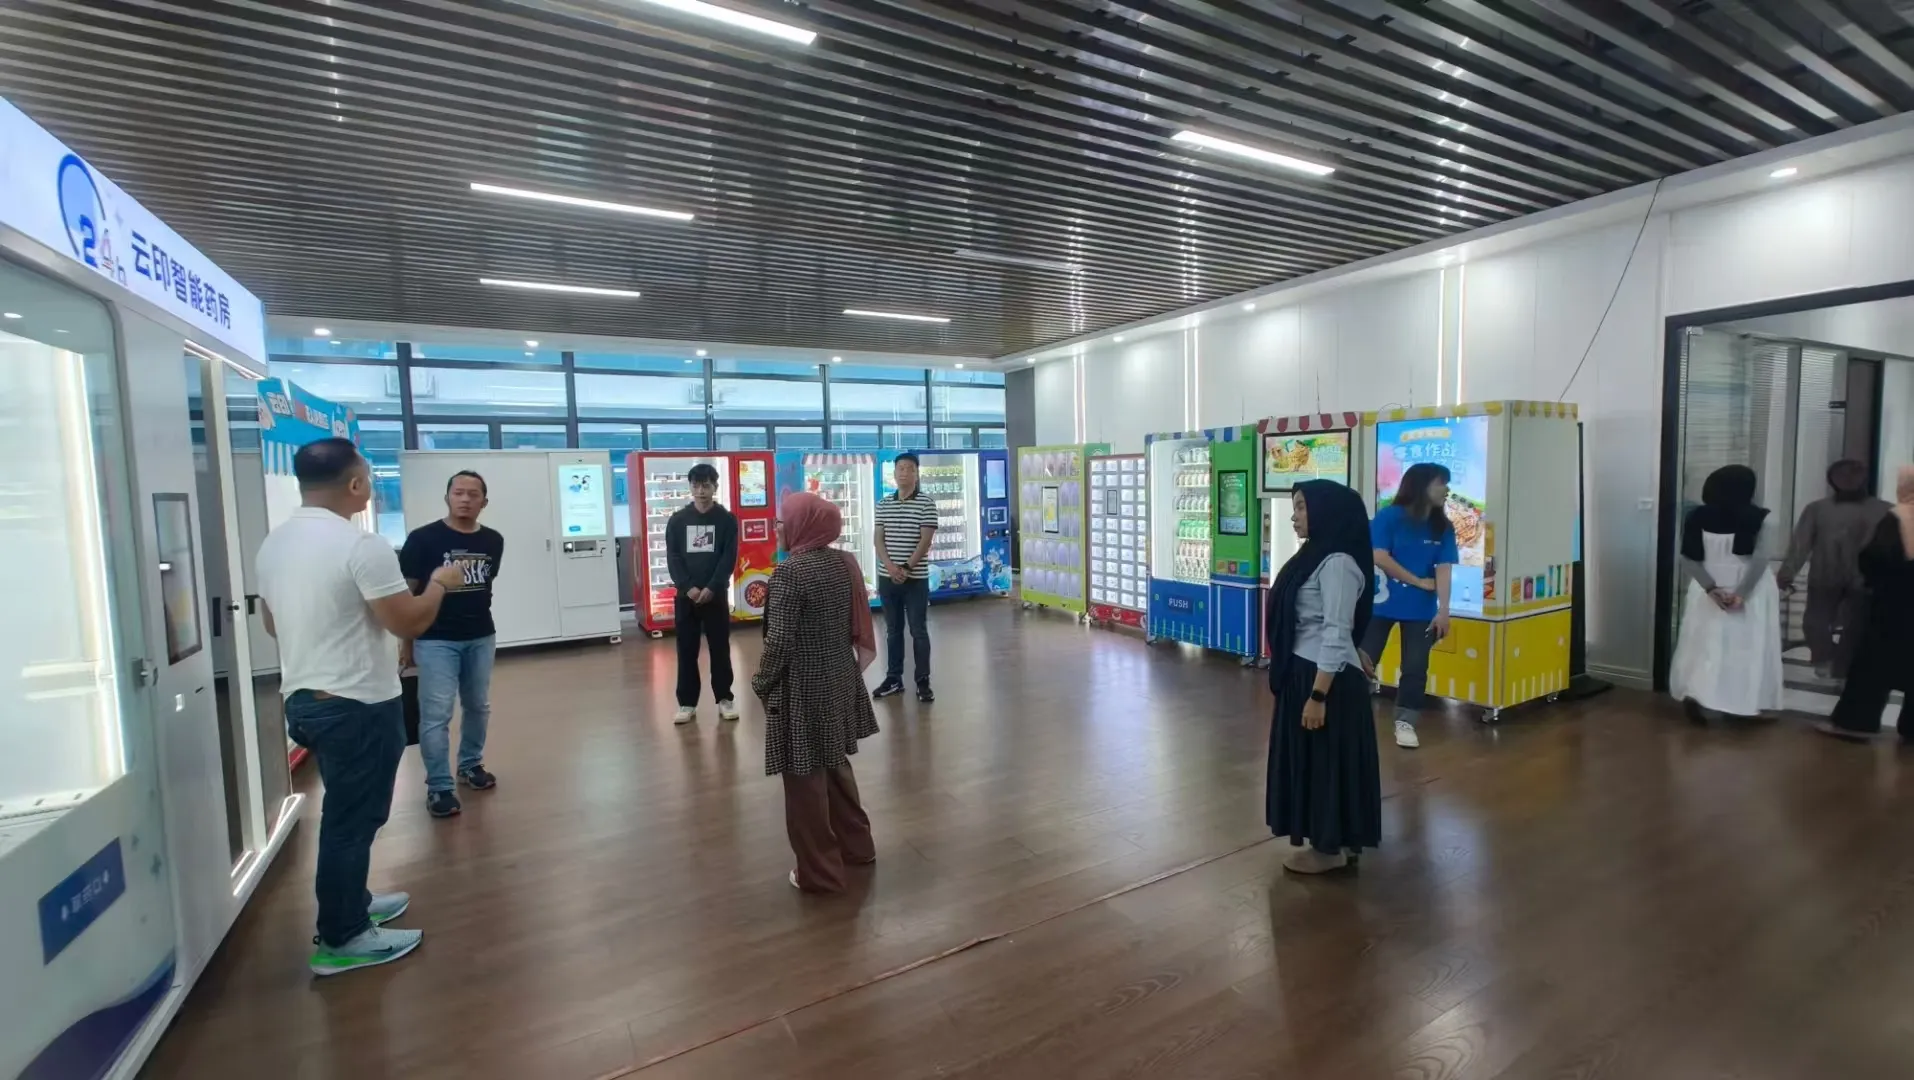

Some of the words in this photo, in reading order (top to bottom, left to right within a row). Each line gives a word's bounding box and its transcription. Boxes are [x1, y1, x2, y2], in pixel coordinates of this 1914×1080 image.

[131, 230, 231, 330] 云印智能药房
[1168, 597, 1189, 609] PUSH
